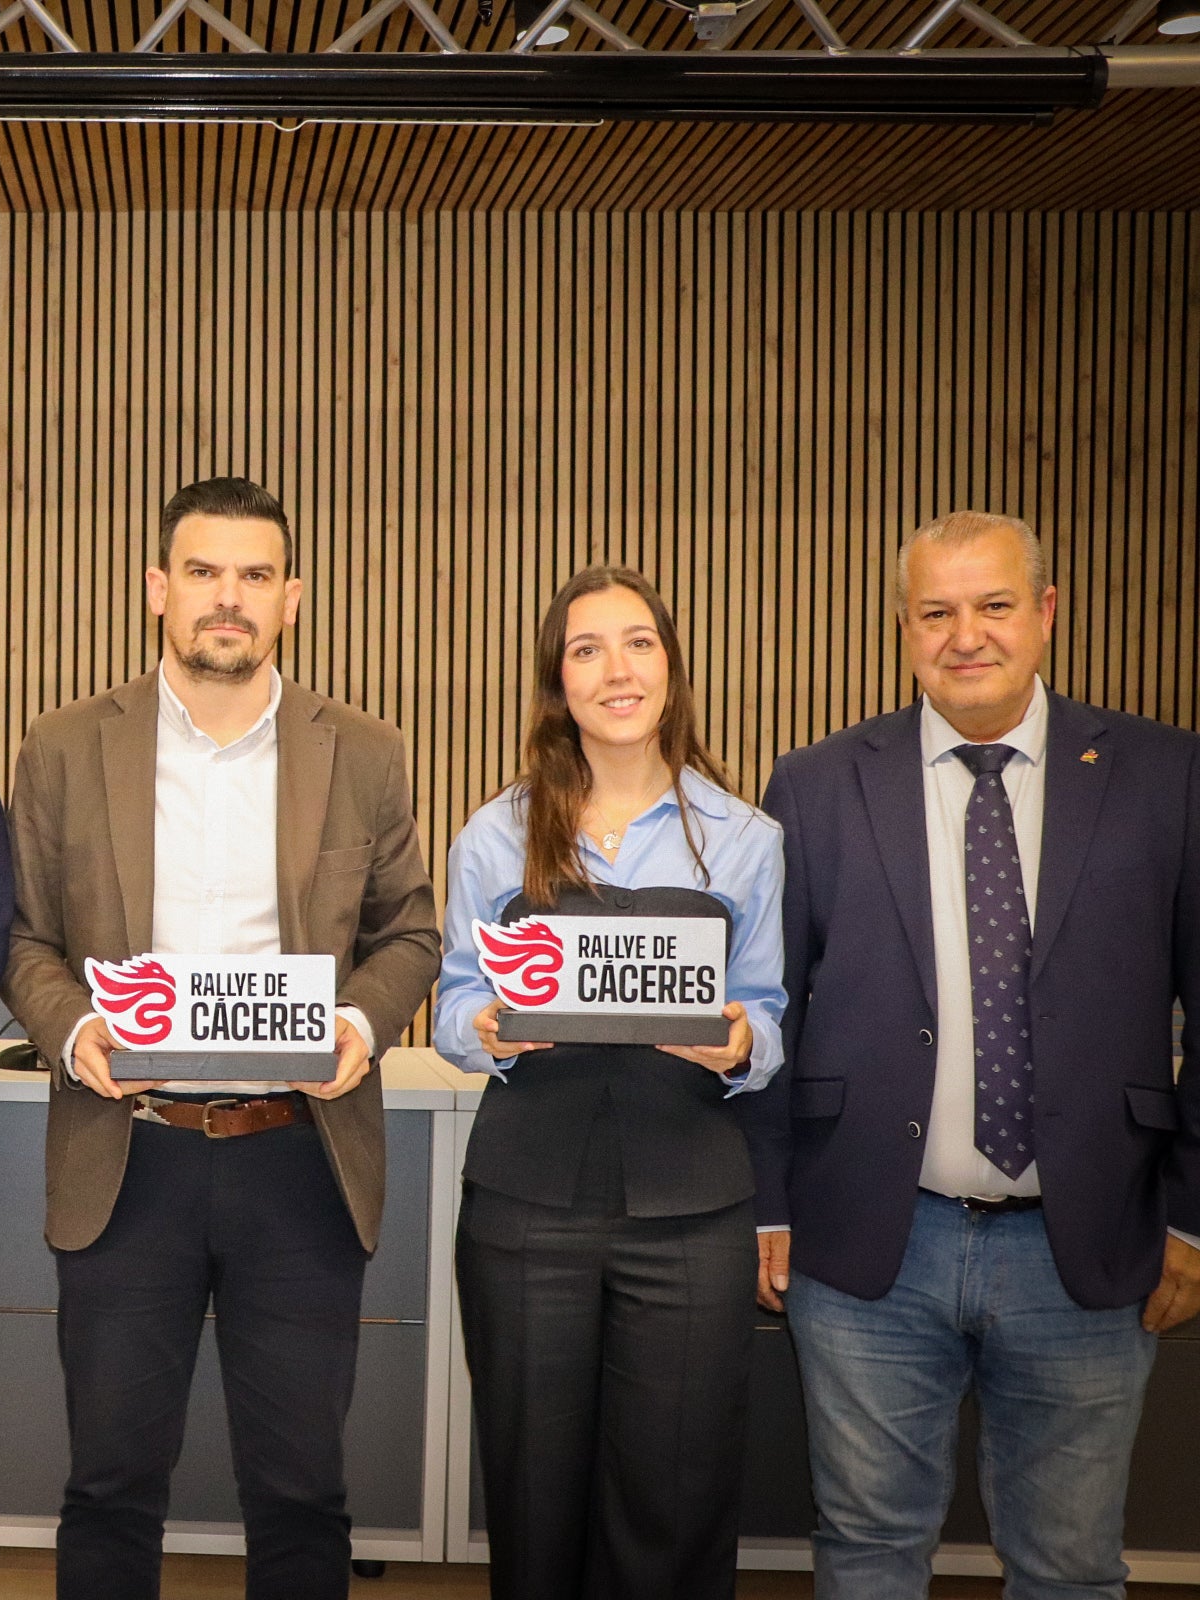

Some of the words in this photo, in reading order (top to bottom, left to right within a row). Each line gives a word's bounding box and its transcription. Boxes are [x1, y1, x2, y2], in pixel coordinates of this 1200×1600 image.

[577, 934, 646, 959] RALLYE
[653, 936, 677, 960] DE
[190, 972, 257, 997] RALLYE
[264, 973, 288, 997] DE
[577, 960, 716, 1004] CÁCERES
[190, 998, 326, 1042] CÁCERES
